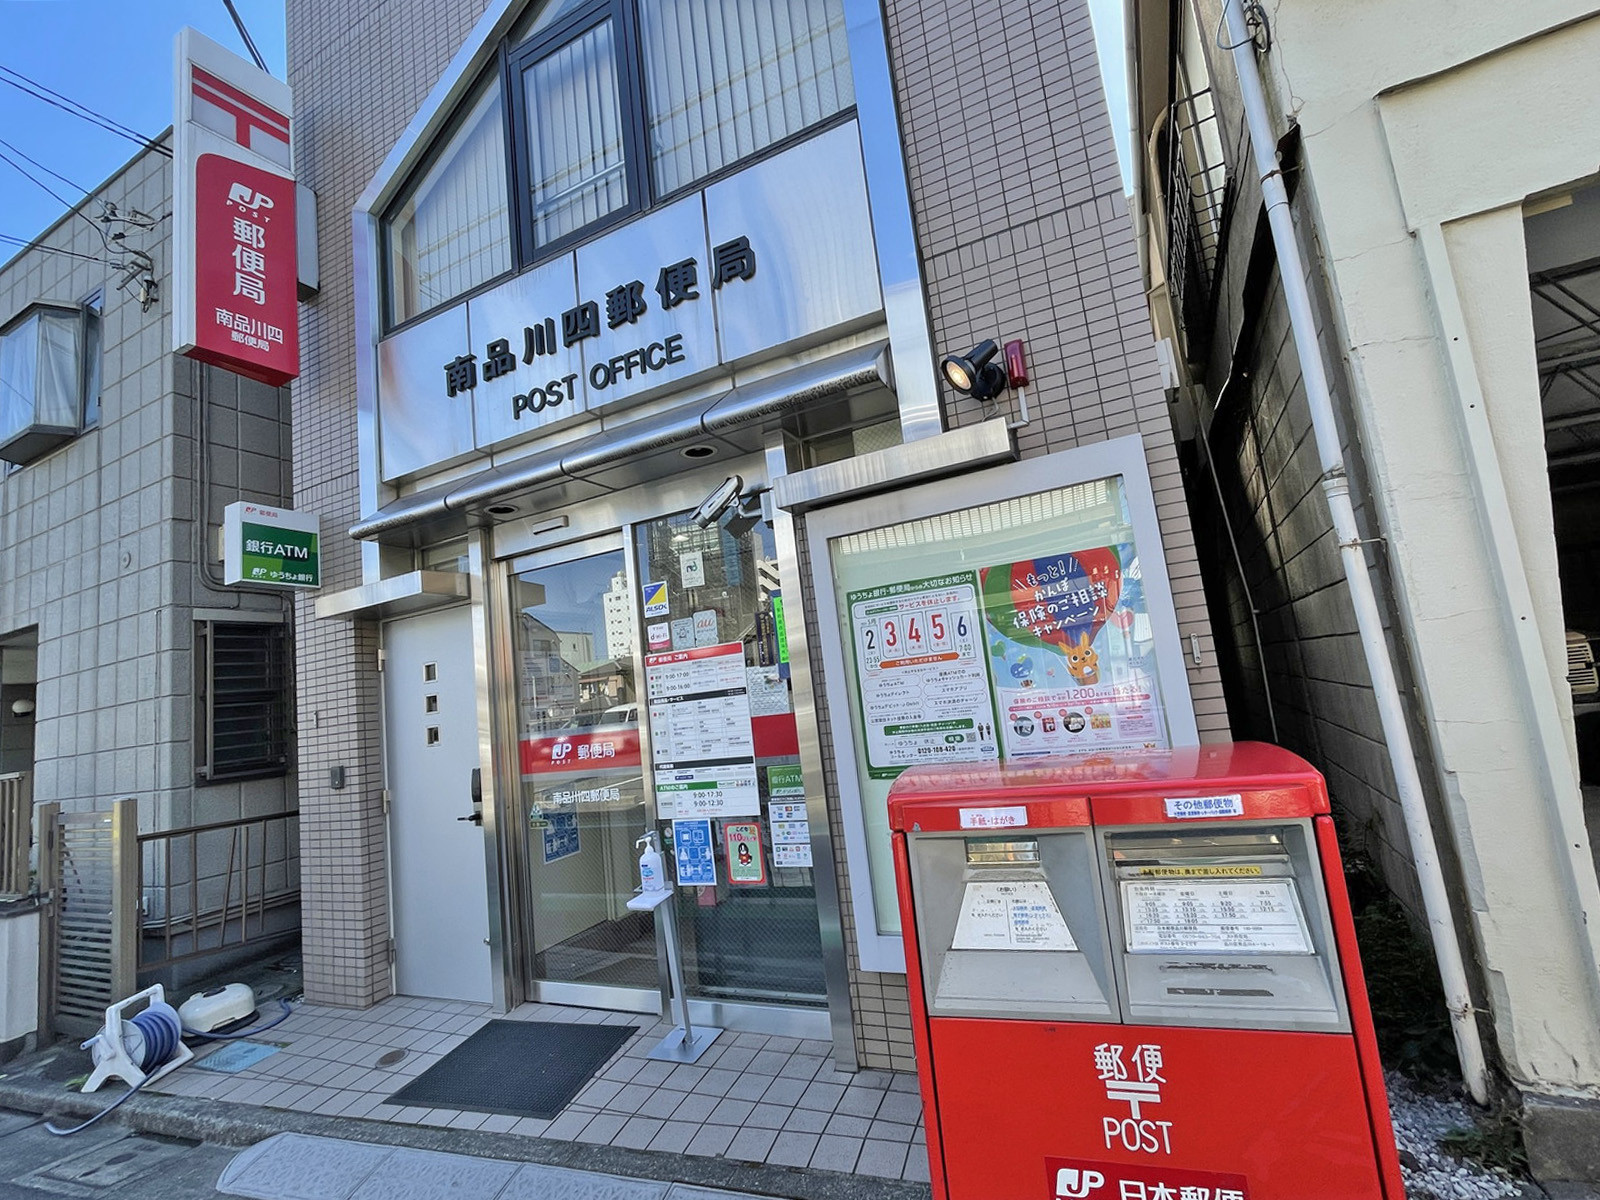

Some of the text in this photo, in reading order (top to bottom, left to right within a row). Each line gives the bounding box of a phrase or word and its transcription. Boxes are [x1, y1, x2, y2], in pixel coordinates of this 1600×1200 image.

[226, 199, 271, 223] POST
[231, 216, 266, 306] 郵便局
[214, 307, 284, 344] 南品川四
[444, 234, 756, 398] 南品川四郵便局
[231, 330, 270, 352] 郵便局
[512, 333, 686, 420] POST OFFICE
[245, 539, 308, 559] 銀行ATM
[270, 571, 313, 582] ゆうちょ銀行
[1034, 577, 1069, 602] かんぽ
[1013, 581, 1108, 629] 保険のご相談
[884, 621, 897, 646] 3
[908, 617, 921, 643] 4
[931, 613, 945, 640] 5
[957, 615, 967, 637] 6
[1032, 605, 1100, 638] キャンペーン
[865, 629, 875, 650] 2
[577, 742, 615, 760] 郵便局
[1174, 798, 1234, 811] その他郵便物
[970, 815, 1015, 827] 手紙・はがき
[1093, 1042, 1167, 1083] 郵便
[1102, 1116, 1172, 1155] POST
